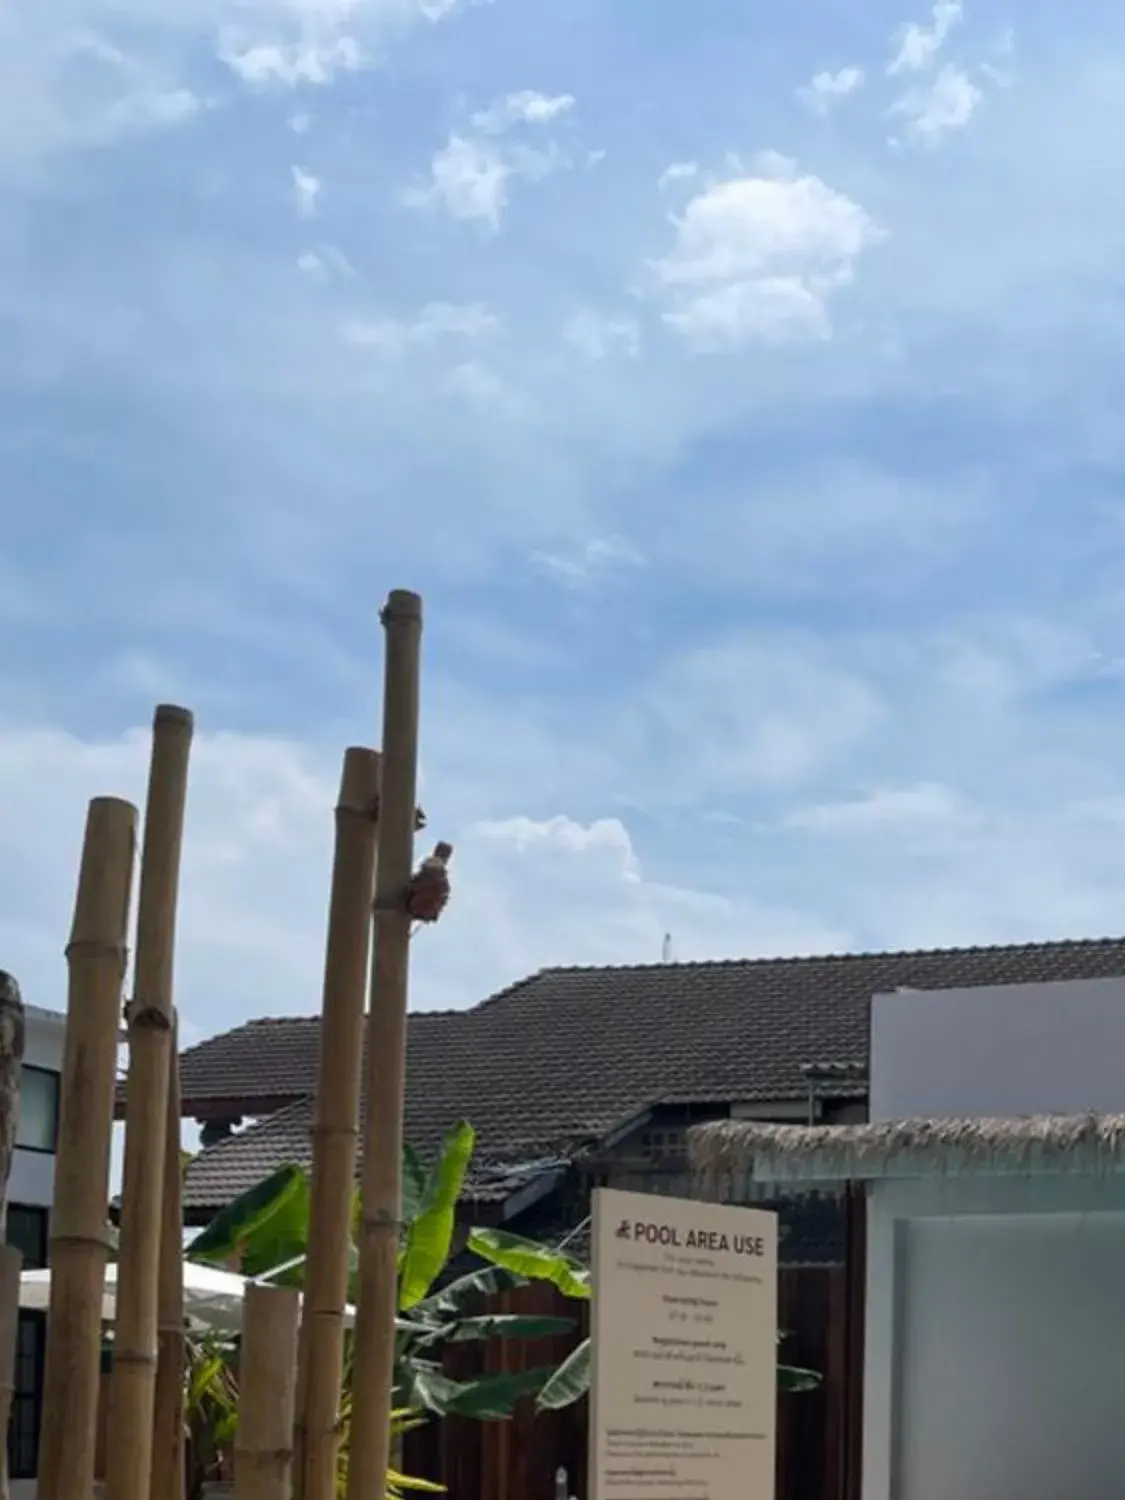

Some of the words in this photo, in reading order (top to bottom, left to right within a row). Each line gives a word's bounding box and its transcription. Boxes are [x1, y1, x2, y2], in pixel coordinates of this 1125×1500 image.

[634, 1222, 681, 1247] POOL
[685, 1230, 730, 1252] AREA
[733, 1236, 765, 1256] USE
